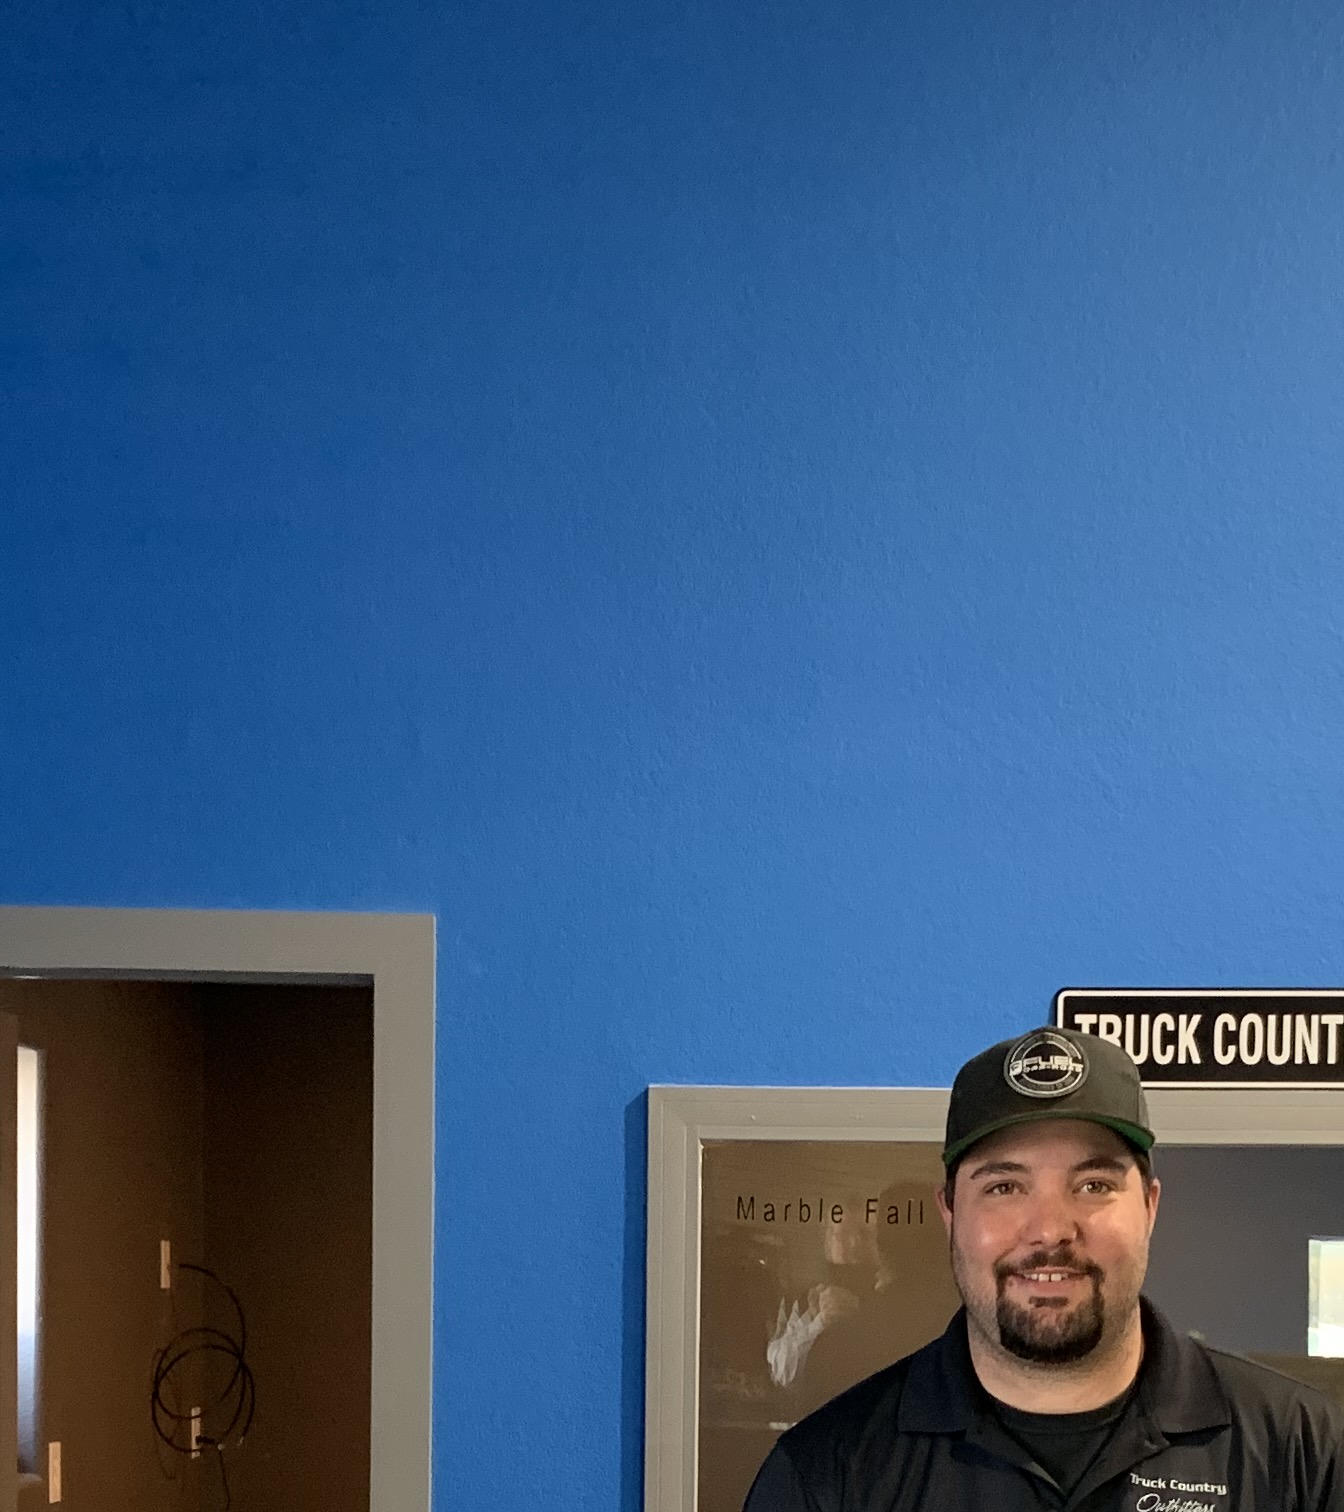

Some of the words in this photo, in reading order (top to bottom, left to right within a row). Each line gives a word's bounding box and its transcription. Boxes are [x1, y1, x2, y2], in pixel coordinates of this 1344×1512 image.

[736, 1195, 844, 1223] Marble
[1129, 1472, 1167, 1489] Truck
[1170, 1479, 1227, 1495] Country
